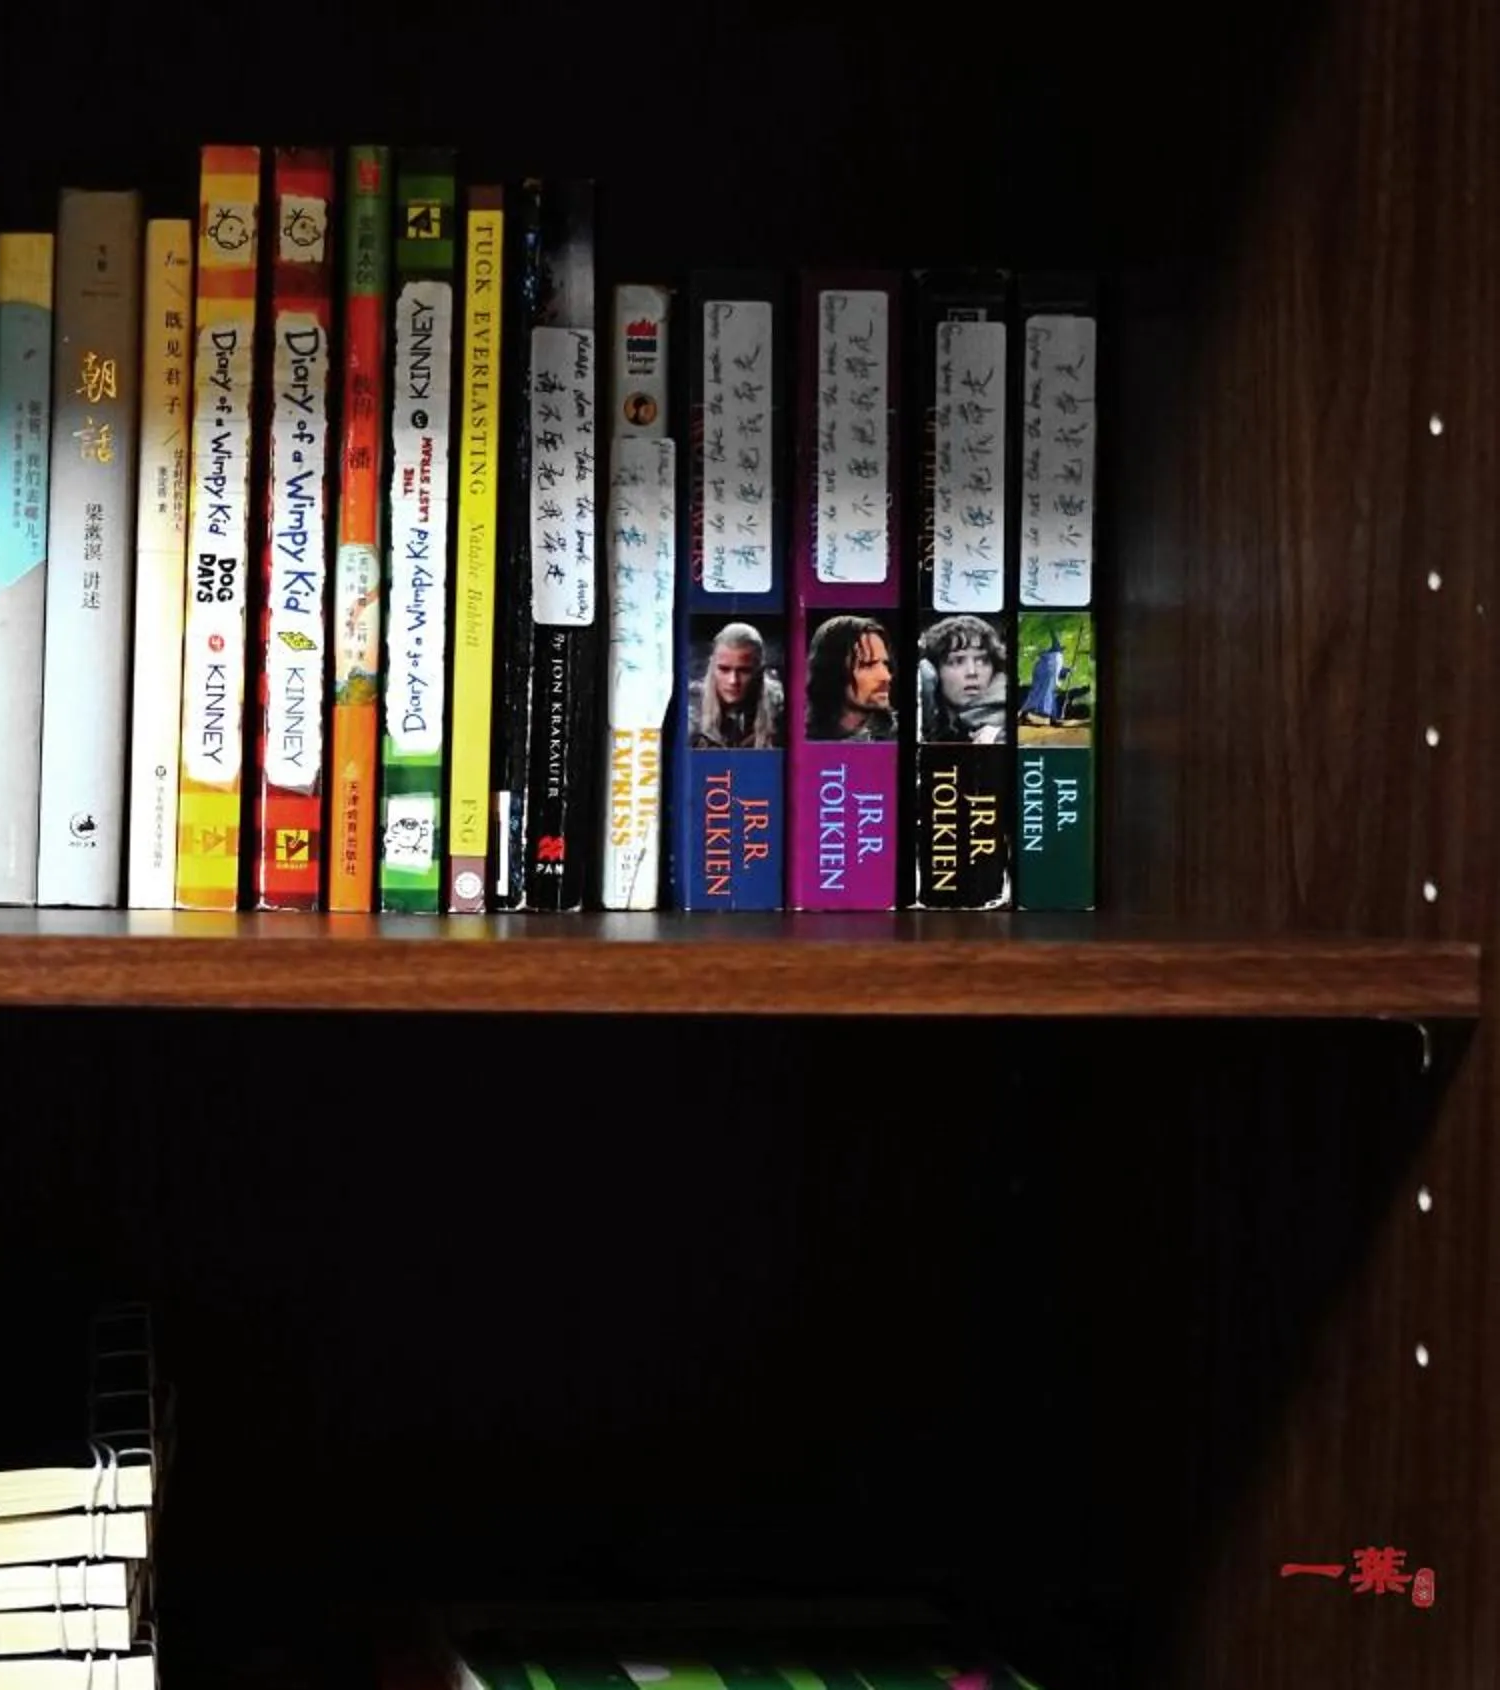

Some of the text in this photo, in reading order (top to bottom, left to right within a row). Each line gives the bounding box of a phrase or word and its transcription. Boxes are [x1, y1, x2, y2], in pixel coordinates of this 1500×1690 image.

[164, 311, 184, 415] 既见君子
[210, 330, 237, 391] Diary
[409, 299, 435, 400] KINNEY
[469, 224, 494, 496] TUCK EVERLASTING
[215, 396, 233, 414] of
[204, 431, 233, 499] Wimpy
[276, 328, 319, 615] Diary of a Wimpy Kid
[574, 447, 594, 482] take
[707, 428, 726, 464] take
[403, 467, 415, 497] THE
[419, 437, 433, 523] LAST STRAW
[708, 477, 725, 504] not
[821, 467, 838, 494] not
[937, 484, 954, 514] not
[1025, 492, 1042, 518] not
[208, 502, 232, 537] Kid
[575, 496, 594, 525] the
[406, 527, 429, 560] Kid
[467, 523, 486, 579] Natalie
[197, 553, 217, 604] DAYS
[215, 557, 236, 602] DOG
[406, 565, 433, 632] Wimpy
[406, 651, 423, 667] of
[551, 658, 564, 694] JON
[202, 663, 227, 765] KINNEY
[283, 667, 306, 768] KINNEY
[402, 672, 429, 733] Diary
[546, 702, 564, 800] KRAKAUER
[611, 728, 634, 847] EXPRESS
[1022, 756, 1045, 852] TOLKIEN
[461, 799, 477, 844] FSG
[705, 769, 732, 896] TOLKIEN
[819, 763, 846, 890] TOLKIEN
[932, 765, 959, 891] TOLKIEN
[535, 863, 564, 875] PAN
